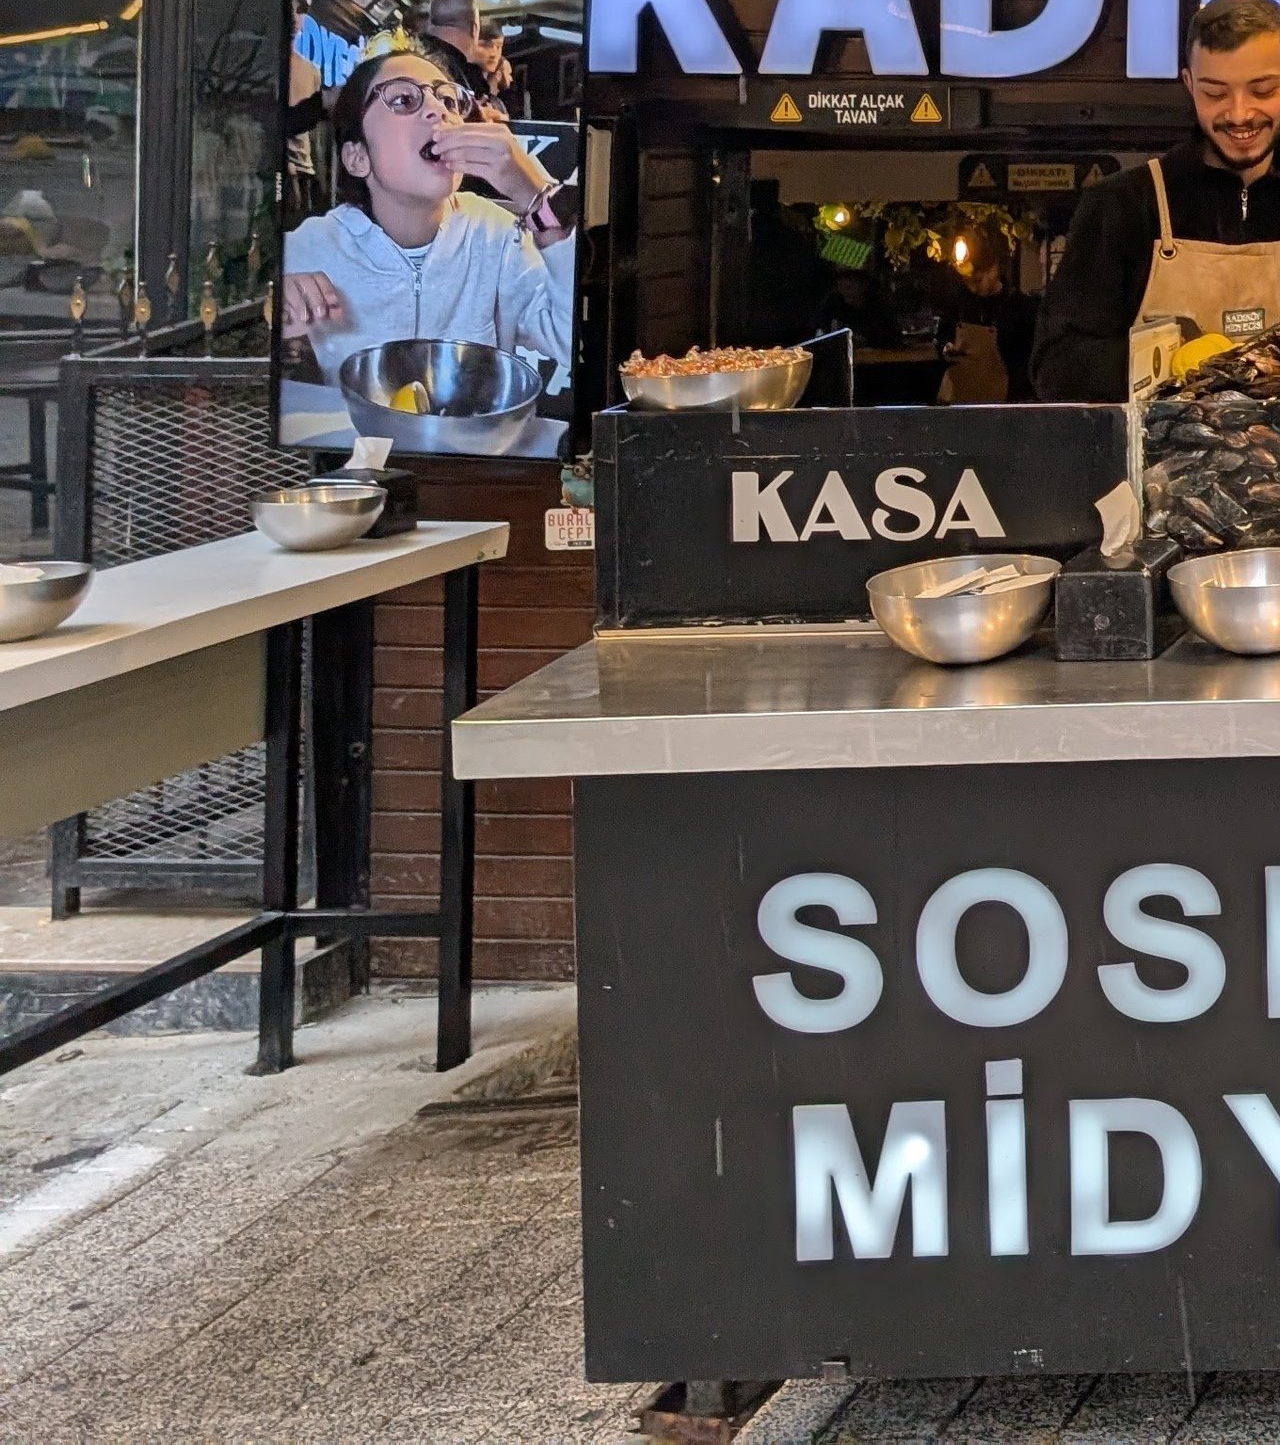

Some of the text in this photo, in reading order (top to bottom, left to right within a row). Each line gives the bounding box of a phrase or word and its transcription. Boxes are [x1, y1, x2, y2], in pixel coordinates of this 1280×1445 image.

[808, 91, 905, 112] DİKKAT ALÇAK
[834, 109, 878, 125] TAVAN
[731, 466, 1006, 542] KASA
